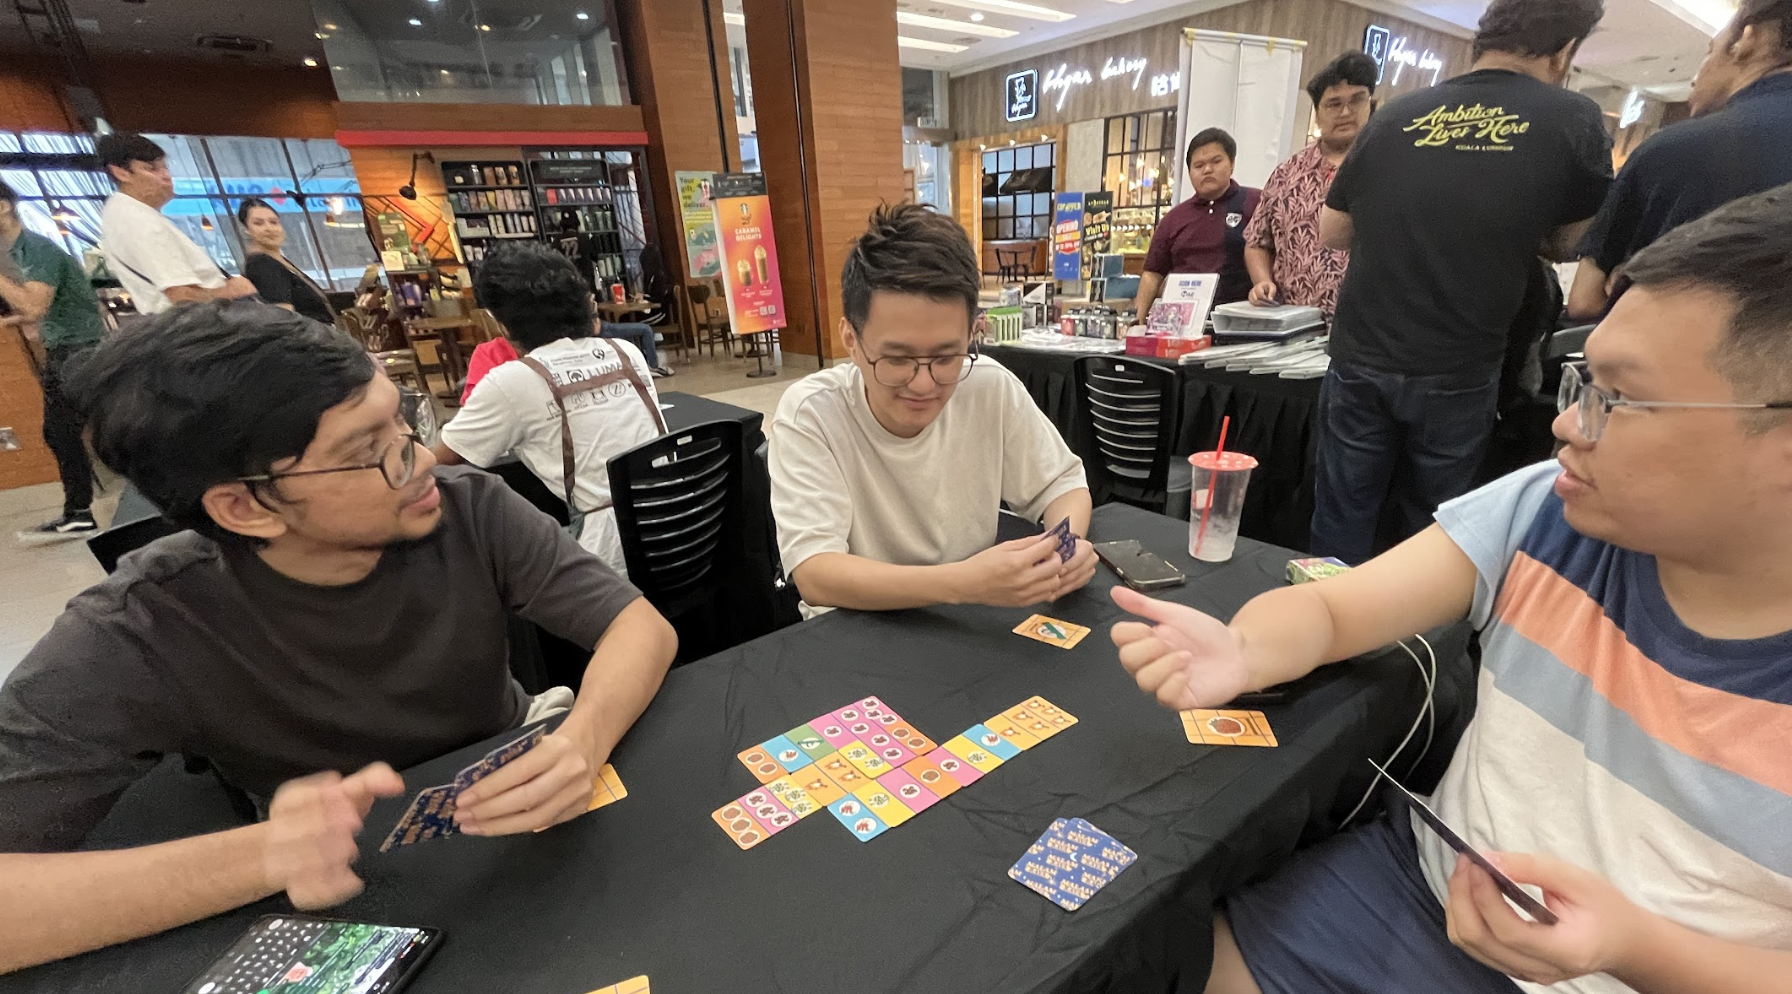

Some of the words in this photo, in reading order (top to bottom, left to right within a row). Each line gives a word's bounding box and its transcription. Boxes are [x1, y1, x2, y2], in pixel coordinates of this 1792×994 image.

[1403, 103, 1505, 132] Ambition
[1414, 123, 1472, 147] Lives
[1471, 114, 1530, 143] Here
[680, 176, 694, 184] Your
[735, 226, 761, 235] CARAMEL
[1085, 224, 1101, 236] Visit
[735, 233, 762, 241] DELIGHTS
